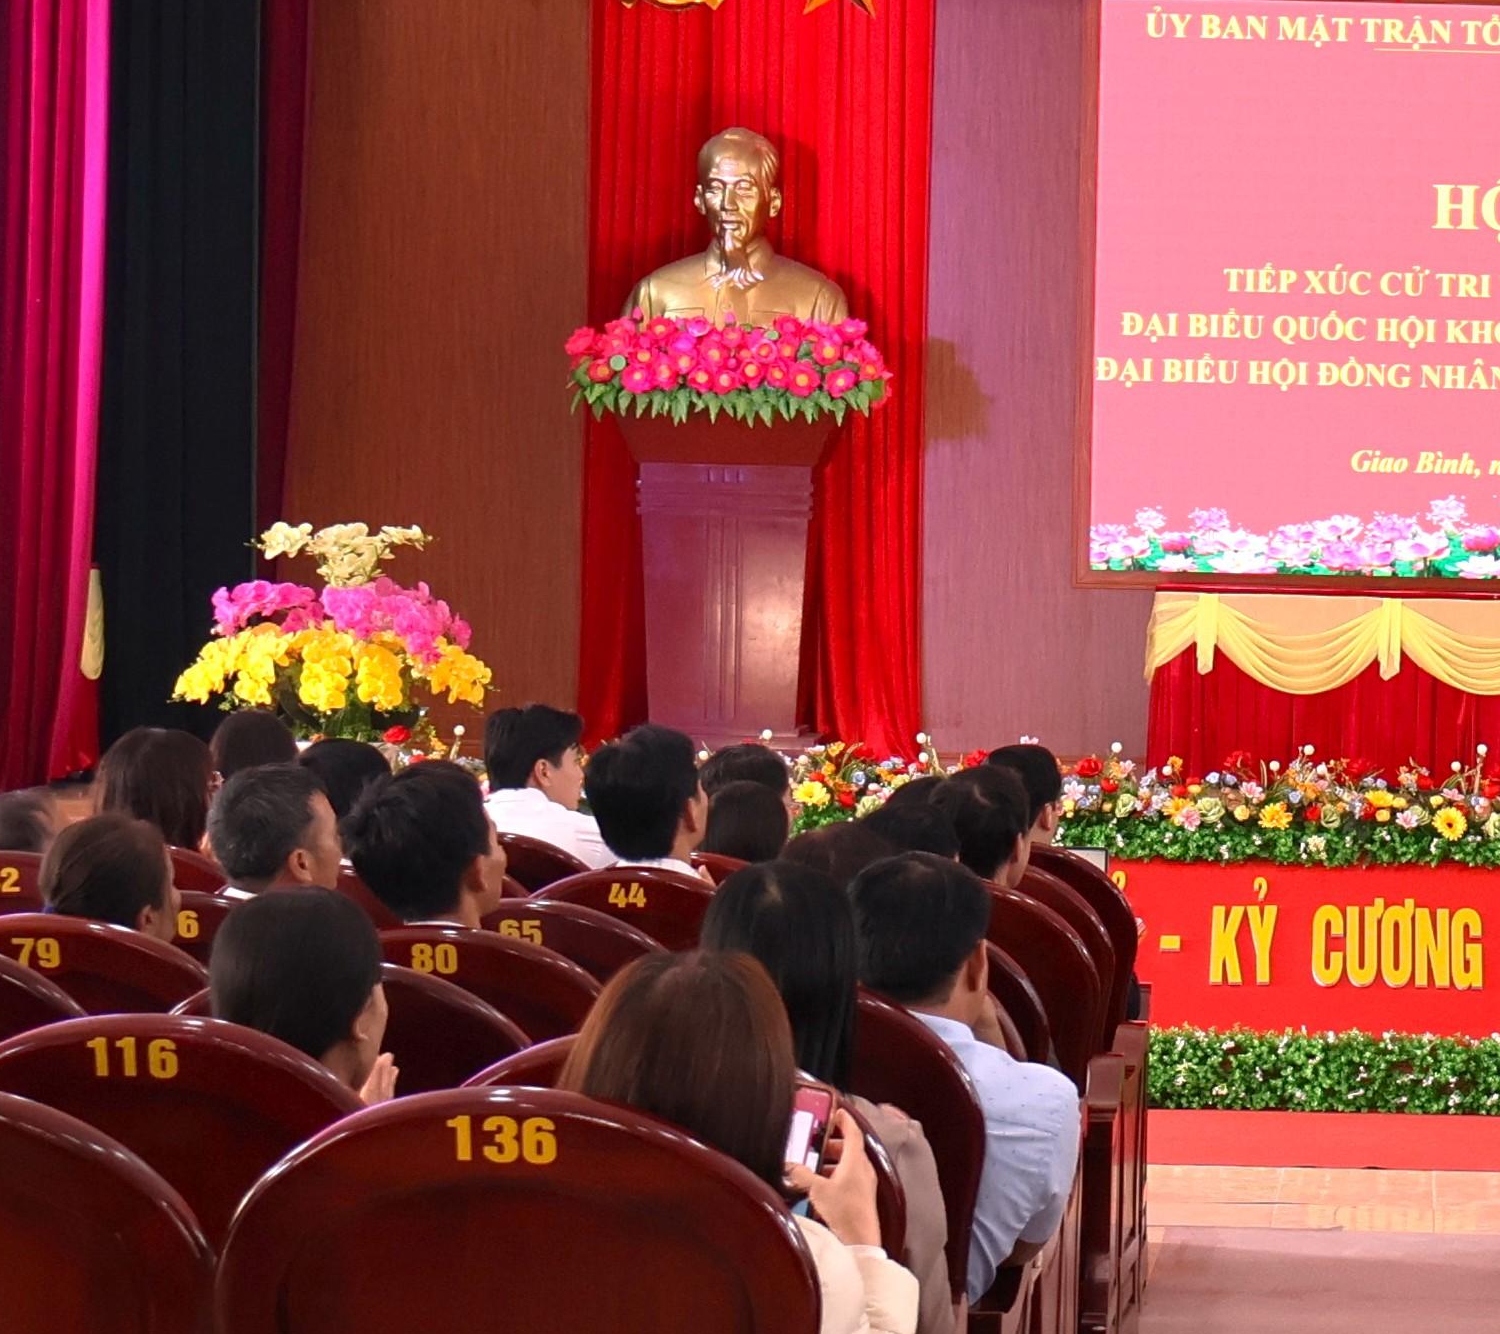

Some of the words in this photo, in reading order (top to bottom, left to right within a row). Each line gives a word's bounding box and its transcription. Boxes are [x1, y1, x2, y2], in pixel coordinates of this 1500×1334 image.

[1147, 6, 1191, 37] ỦY
[1201, 15, 1267, 39] BAN
[1278, 15, 1353, 47] MẶT
[1361, 15, 1452, 50] TRẬN
[1224, 263, 1297, 293] TIẾP
[1304, 264, 1371, 295] XÚC
[1380, 266, 1430, 296] CỬ
[1436, 274, 1490, 297] TRI
[1122, 312, 1178, 342] ĐẠI
[1188, 308, 1263, 339] BIỂU
[1273, 311, 1366, 344] QUỐC
[1377, 316, 1436, 348] HỘI
[1096, 357, 1152, 387] ĐẠI
[1162, 353, 1238, 383] BIỂU
[1249, 358, 1308, 391] HỘI
[1318, 357, 1411, 387] ĐỒNG
[1351, 450, 1408, 473] Giao
[1414, 451, 1481, 478] Bình,
[609, 883, 646, 907] 44
[1209, 877, 1277, 984] KỶ
[1312, 898, 1482, 990] CƯƠNG
[12, 938, 61, 969] 79
[411, 943, 458, 975] 80
[87, 1037, 177, 1078] 116
[447, 1115, 556, 1164] 136
